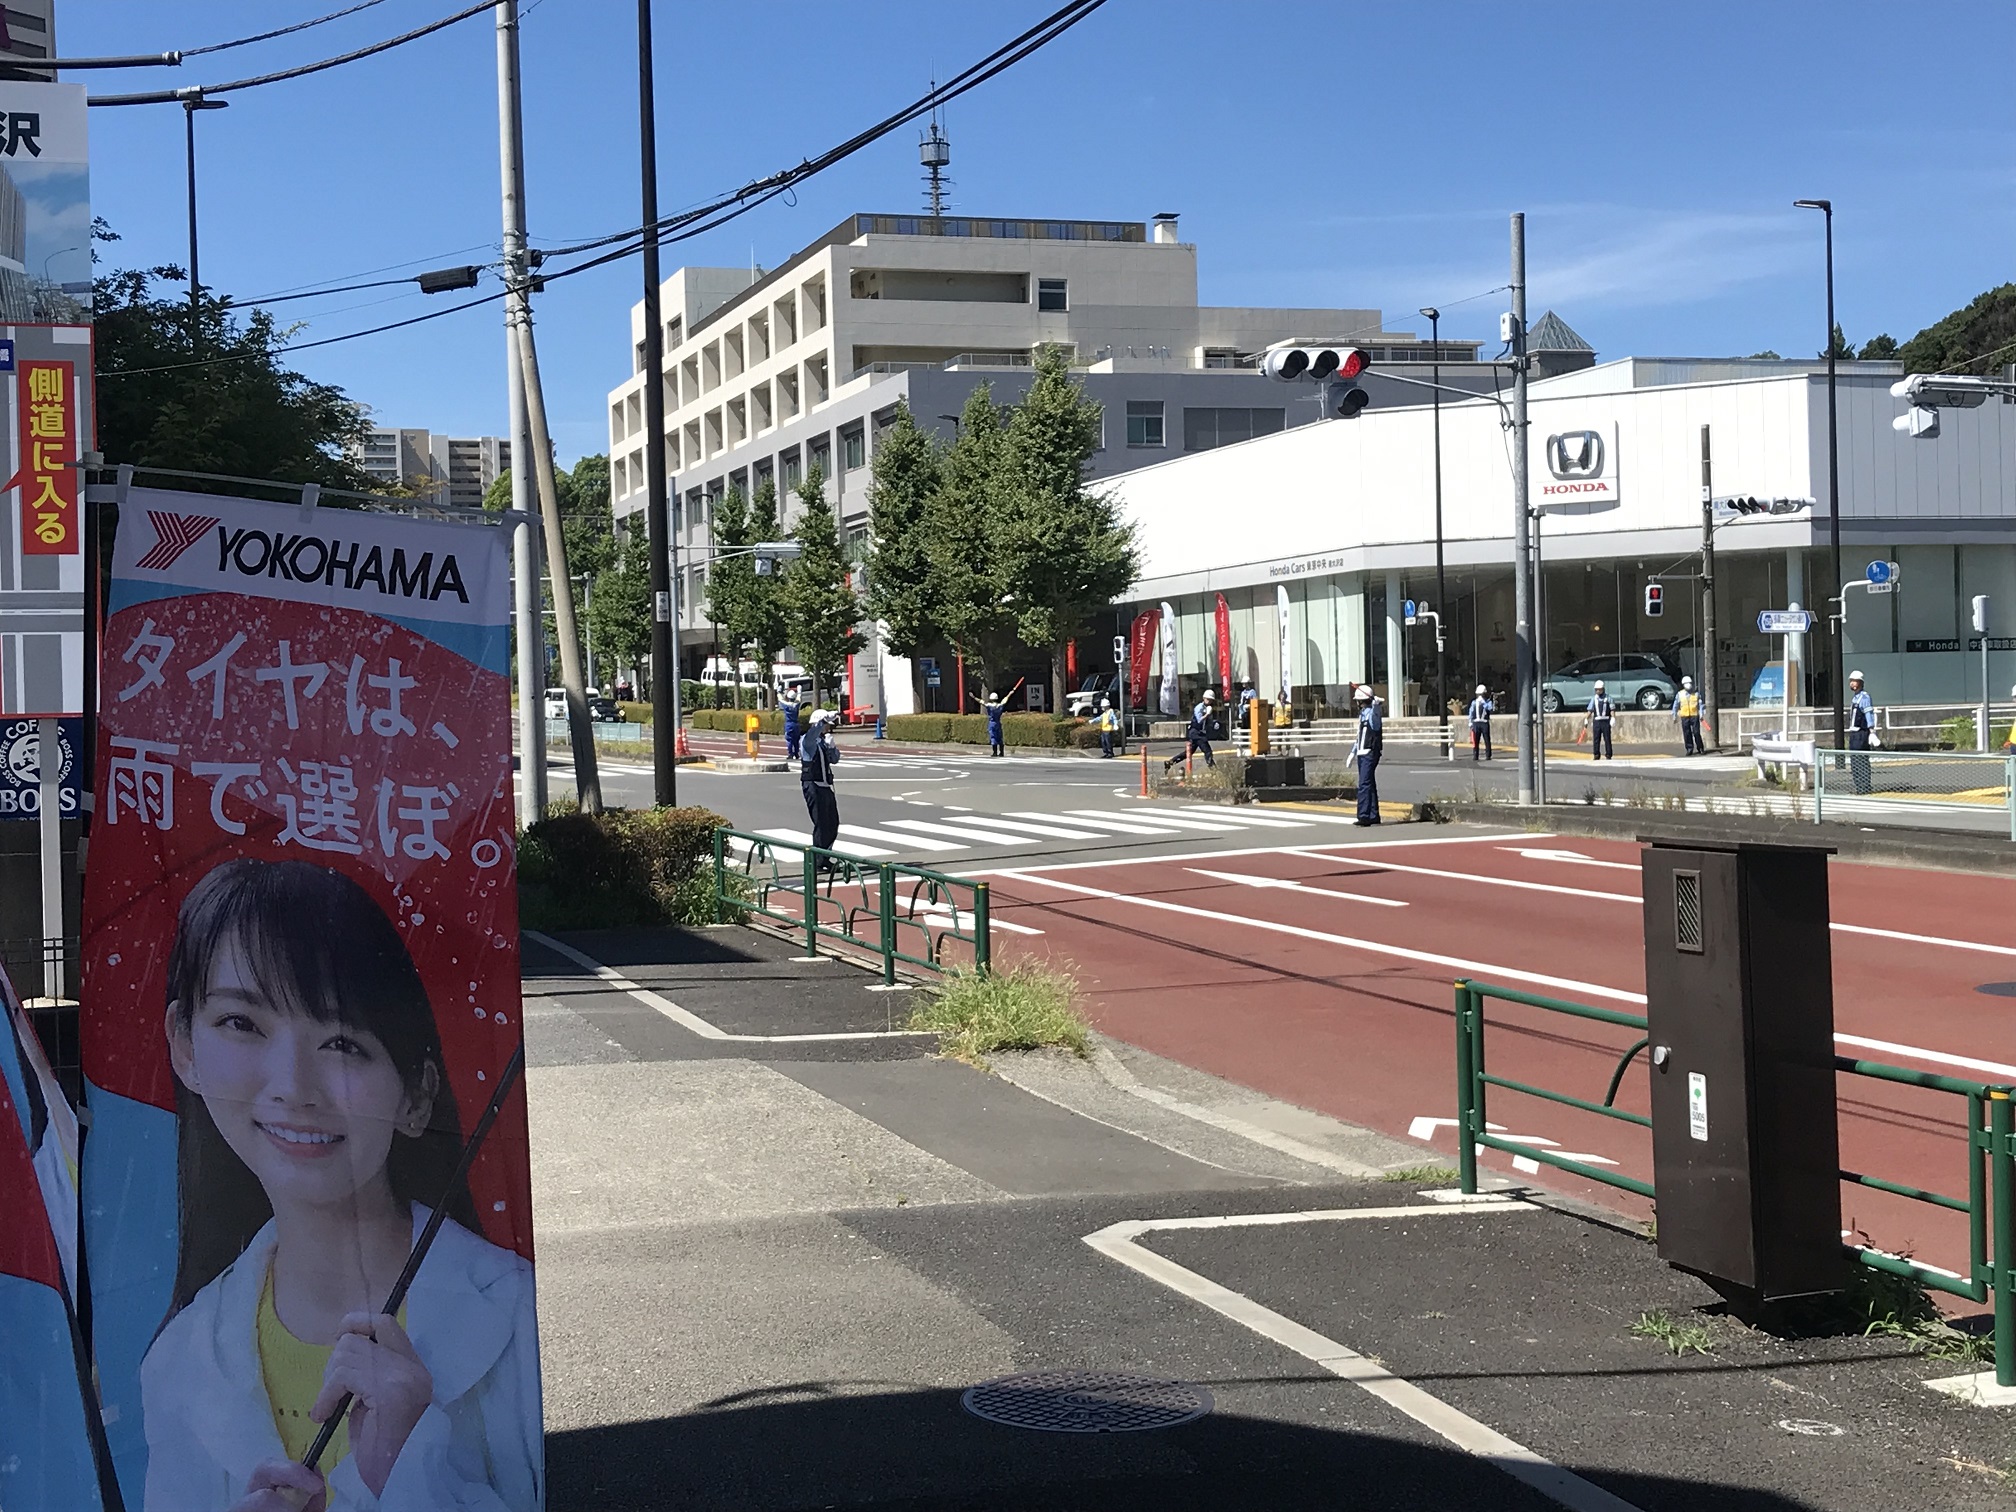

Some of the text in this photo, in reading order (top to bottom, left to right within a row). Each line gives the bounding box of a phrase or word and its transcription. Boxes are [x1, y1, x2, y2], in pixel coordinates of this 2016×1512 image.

[0, 111, 42, 158] 沢
[29, 368, 67, 544] 側道に入る
[1543, 483, 1609, 495] HONDA
[218, 526, 470, 604] YOKOHAMA
[1270, 564, 1290, 577] Honda
[1291, 563, 1306, 574] Cars
[1928, 641, 1959, 651] Honda
[119, 617, 459, 749] タイヤは、
[58, 738, 74, 783] BOSS COFF
[0, 787, 76, 813] BOS
[107, 735, 501, 869] 雨で選ぼ。
